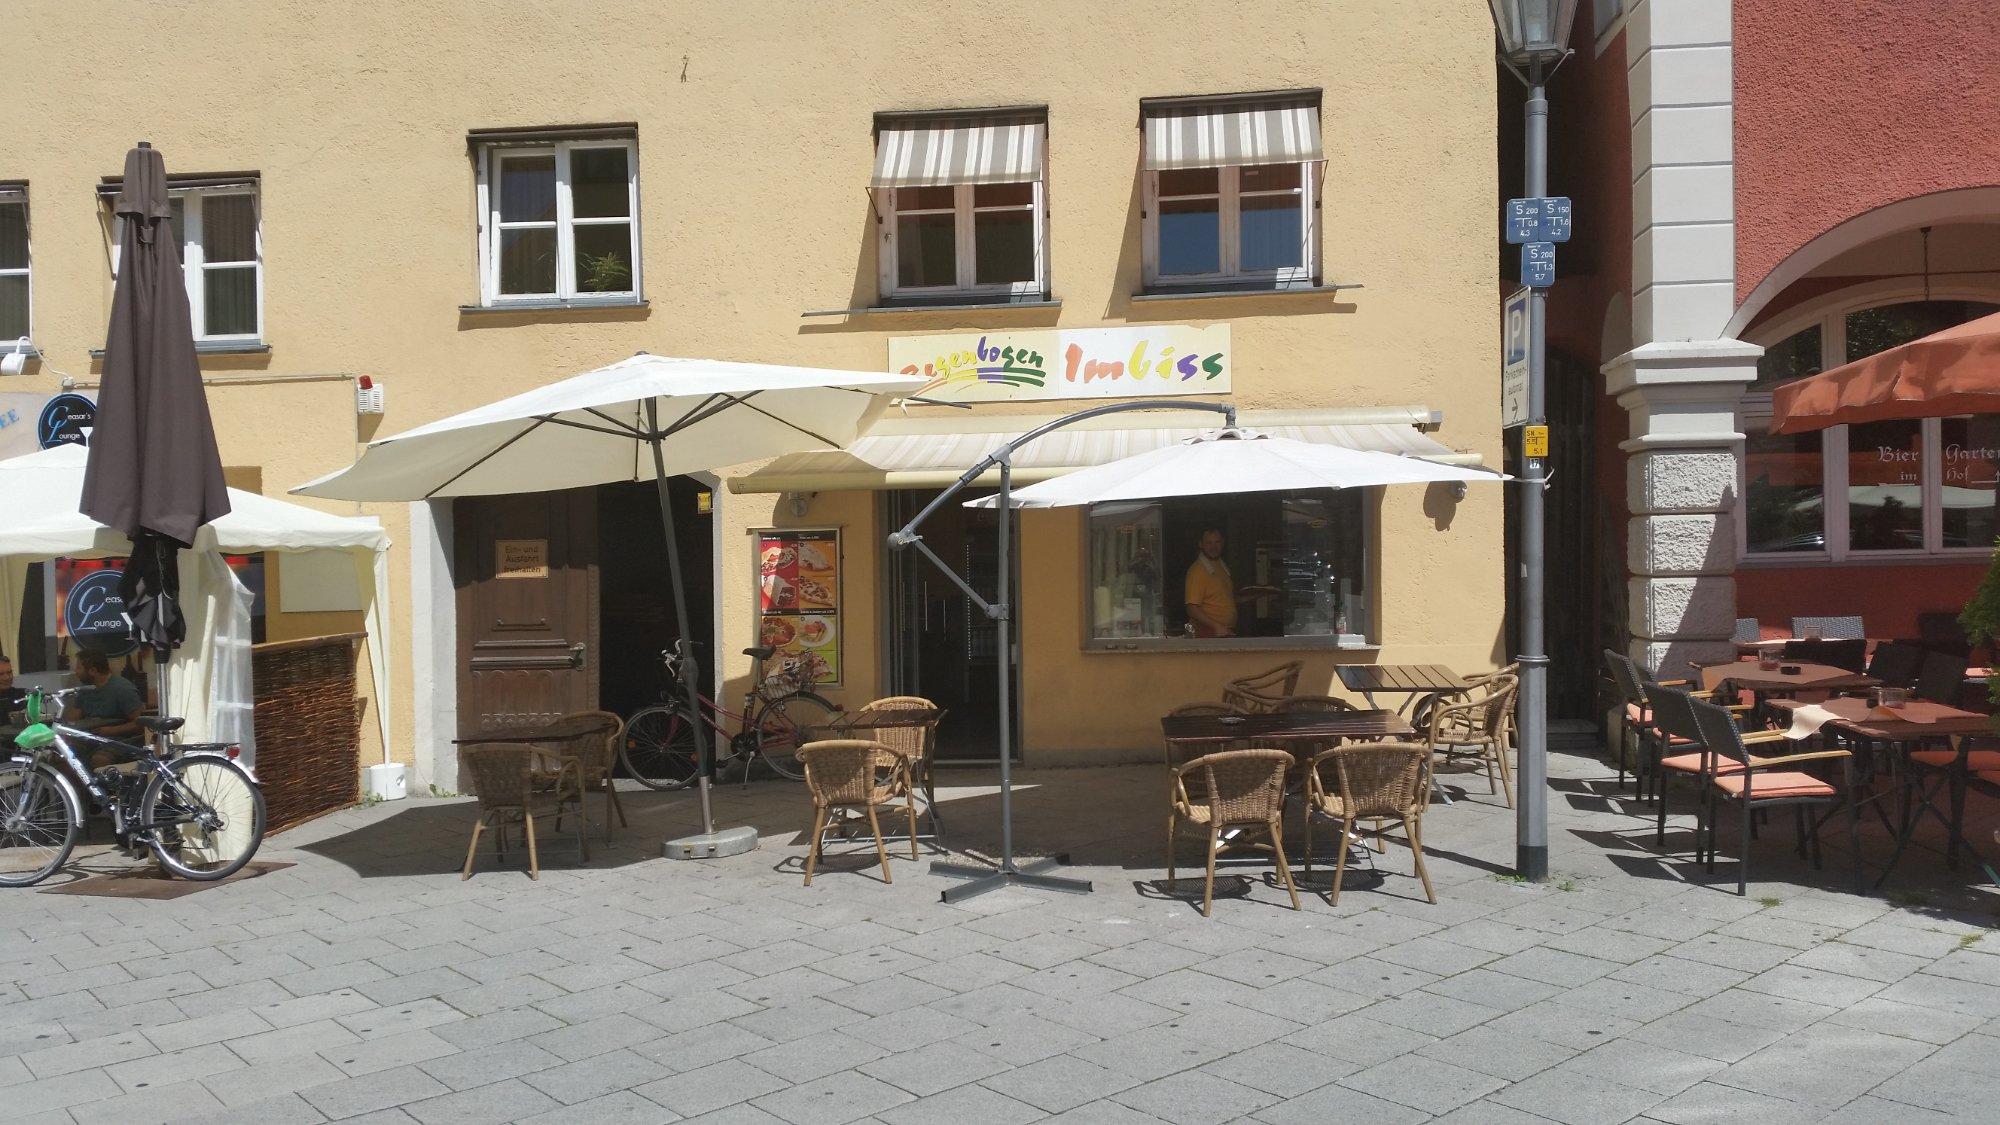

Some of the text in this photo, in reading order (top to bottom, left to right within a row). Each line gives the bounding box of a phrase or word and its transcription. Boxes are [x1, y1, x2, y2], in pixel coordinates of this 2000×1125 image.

[1557, 206, 1570, 214] 150
[1511, 309, 1522, 357] P
[1065, 339, 1225, 384] Imbiss
[1878, 445, 1920, 462] Bier
[1900, 464, 1970, 484] im Hof
[74, 604, 122, 631] Lounge
